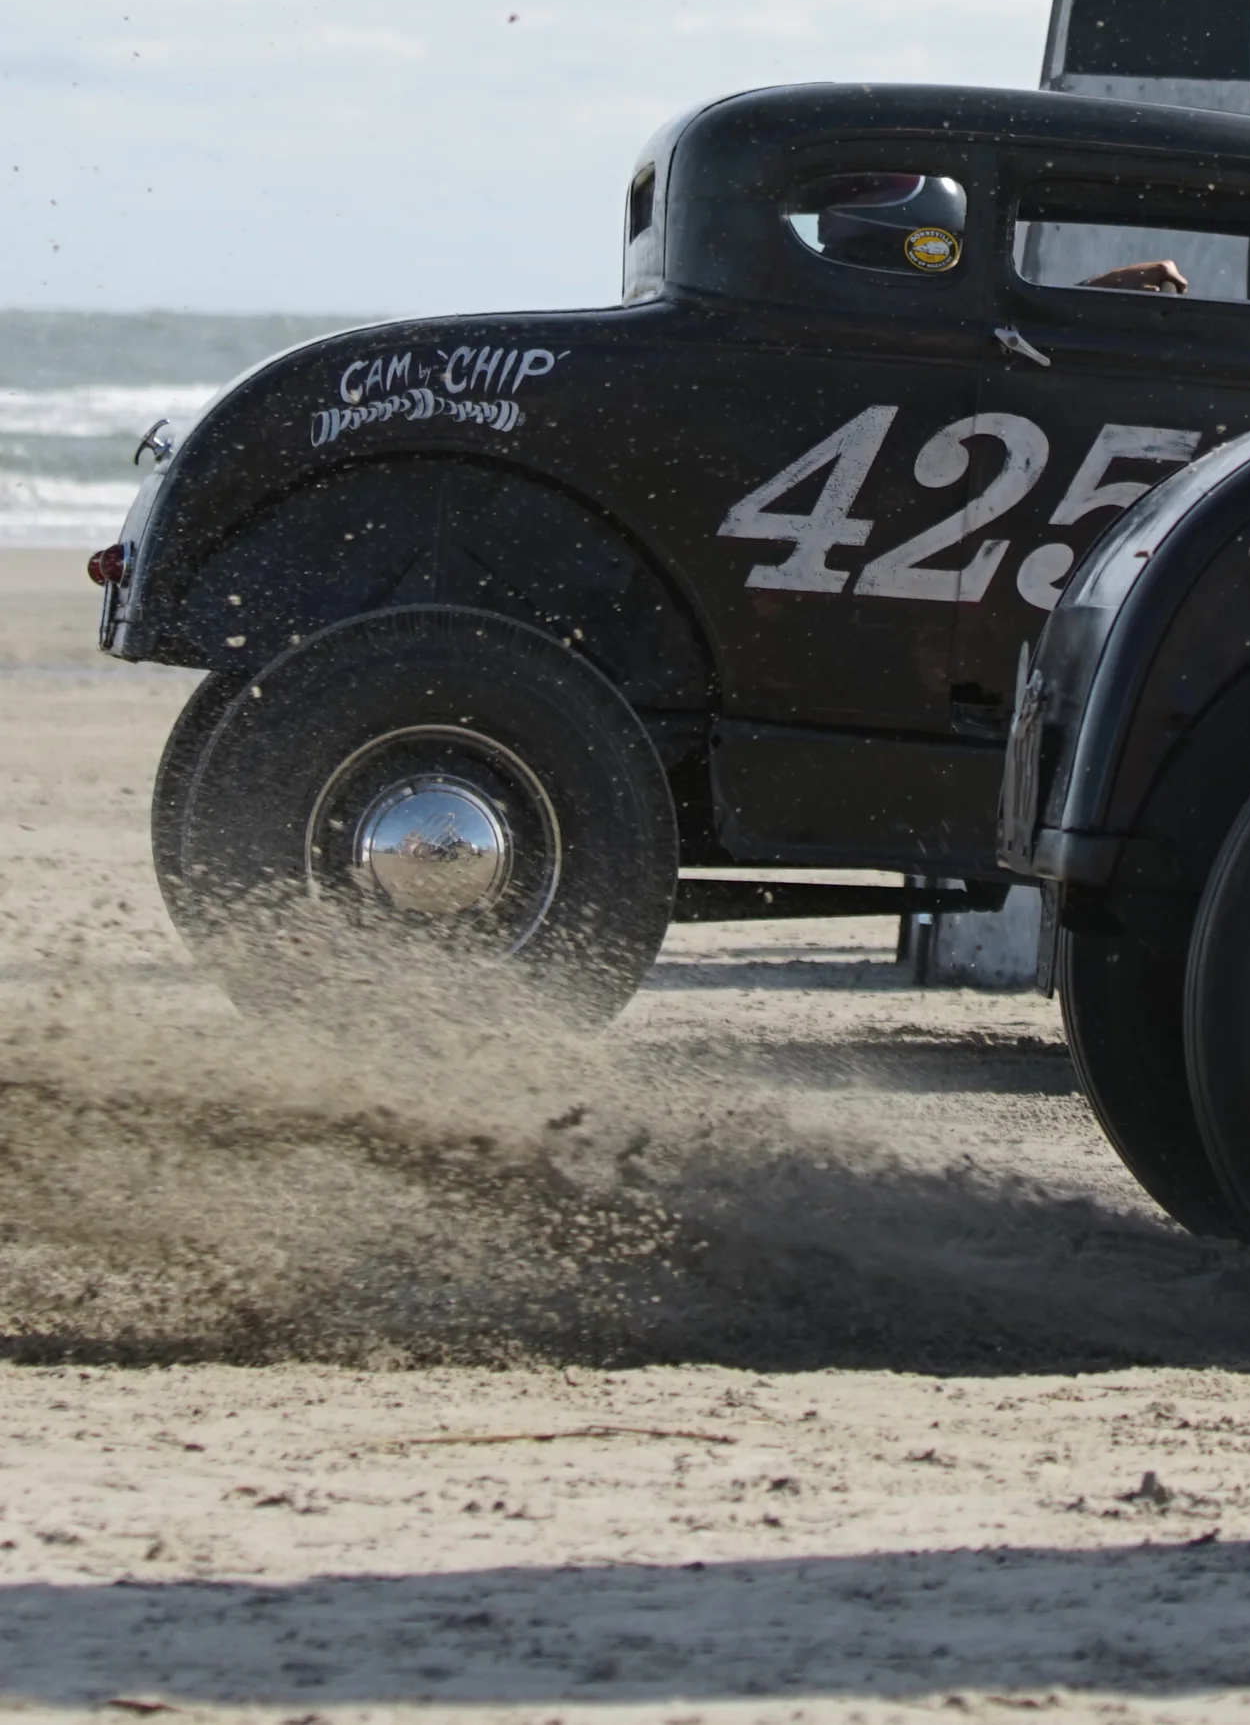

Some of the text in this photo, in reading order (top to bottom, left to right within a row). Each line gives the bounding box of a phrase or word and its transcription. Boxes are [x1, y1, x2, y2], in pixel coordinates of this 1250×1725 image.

[340, 351, 412, 404] CAM
[418, 363, 432, 386] by
[716, 404, 1202, 612] 425
